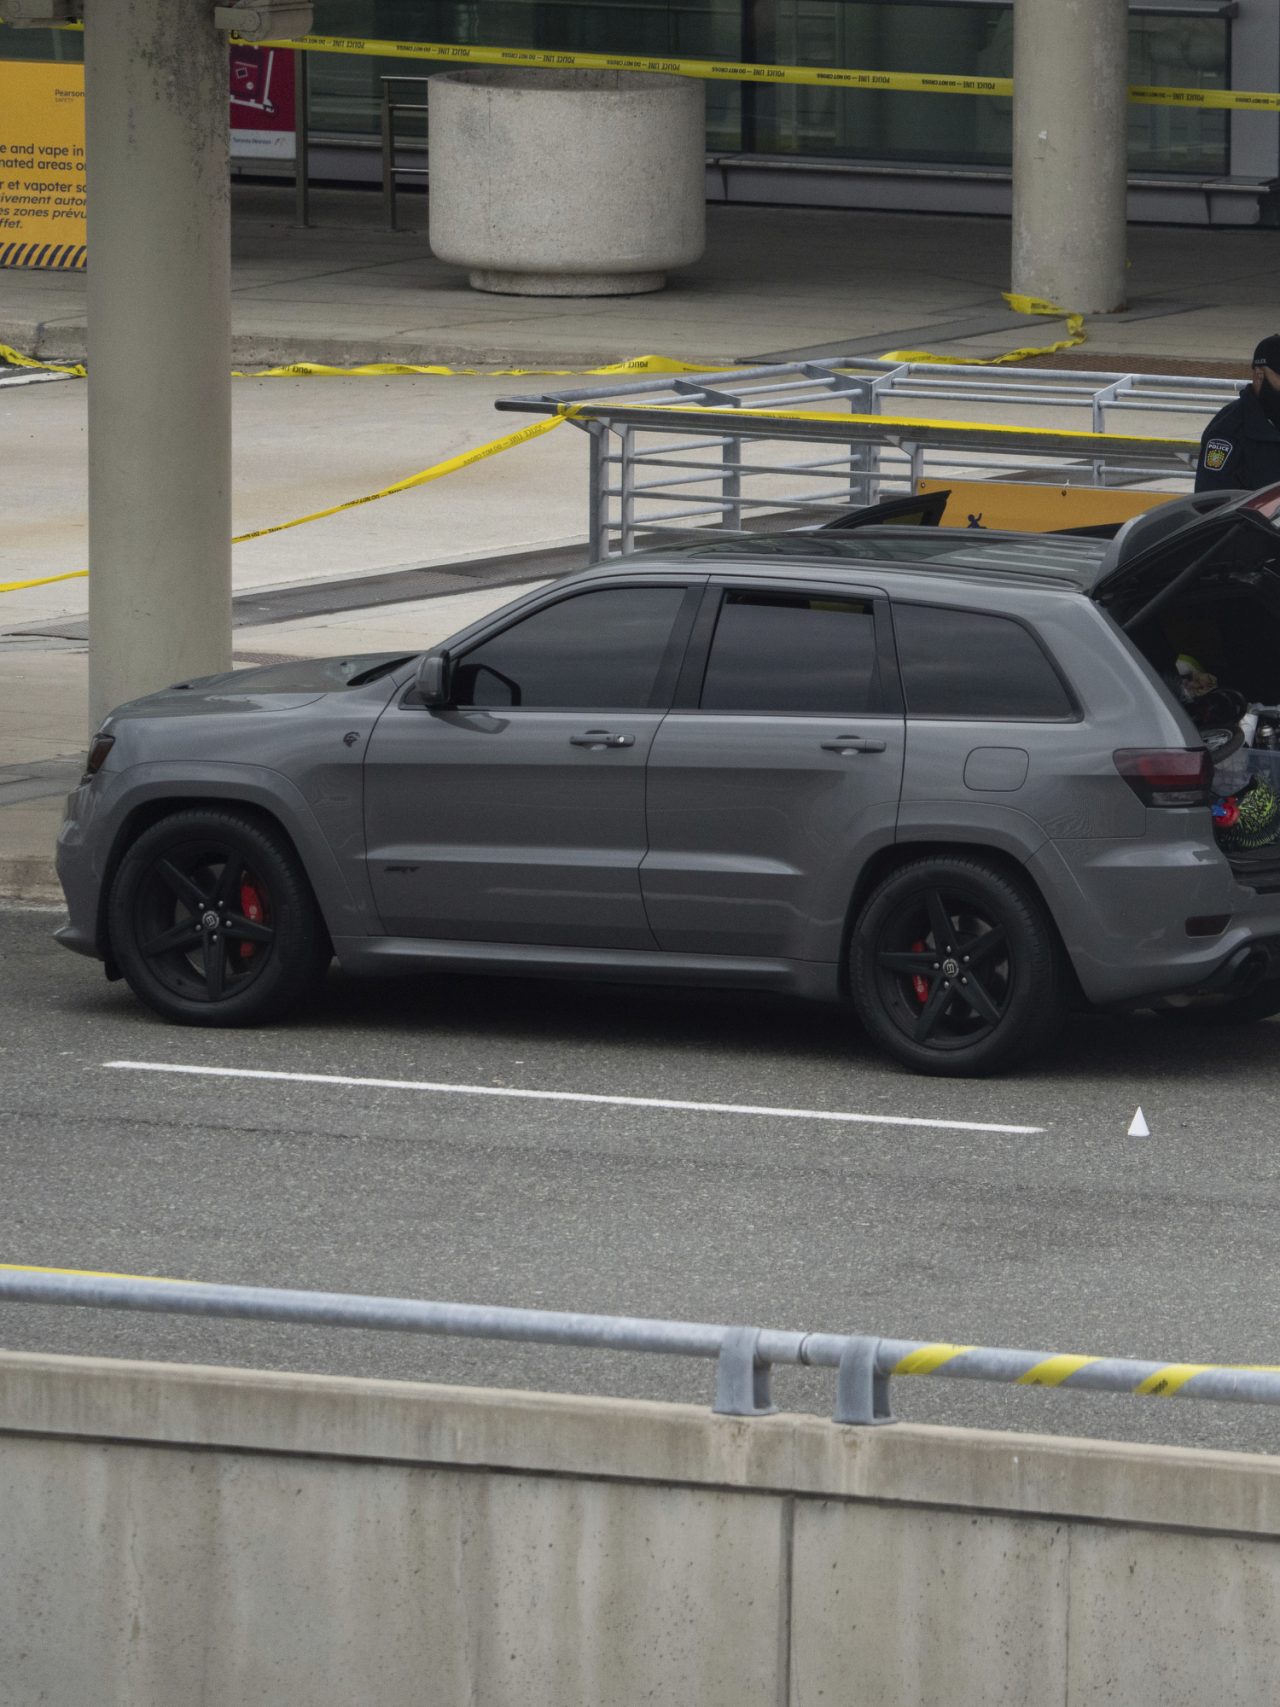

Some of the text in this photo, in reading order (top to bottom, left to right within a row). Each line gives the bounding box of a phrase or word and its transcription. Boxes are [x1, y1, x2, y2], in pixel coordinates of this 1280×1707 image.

[872, 76, 890, 84] POLICE
[55, 88, 85, 97] Pearson
[10, 144, 34, 154] and
[39, 146, 68, 158] vape
[72, 145, 83, 156] in
[38, 161, 72, 171] areas
[8, 180, 20, 190] et
[24, 182, 72, 194] vapoter
[14, 208, 49, 217] zones
[1209, 444, 1230, 452] POLICE
